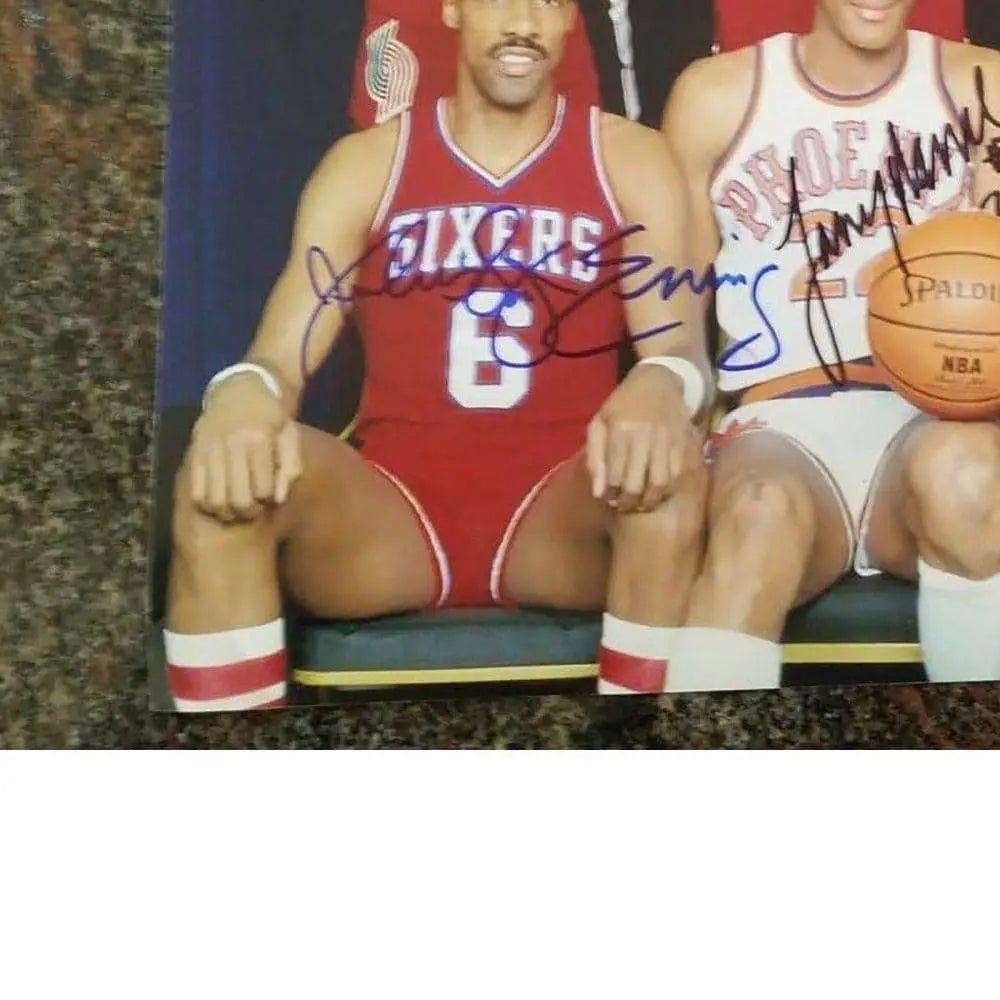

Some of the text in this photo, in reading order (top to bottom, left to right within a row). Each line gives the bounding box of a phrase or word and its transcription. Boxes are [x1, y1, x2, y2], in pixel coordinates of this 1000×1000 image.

[715, 119, 972, 243] PHOE
[387, 203, 603, 284] SIXERS
[449, 288, 534, 409] 6
[942, 355, 982, 374] NBA
